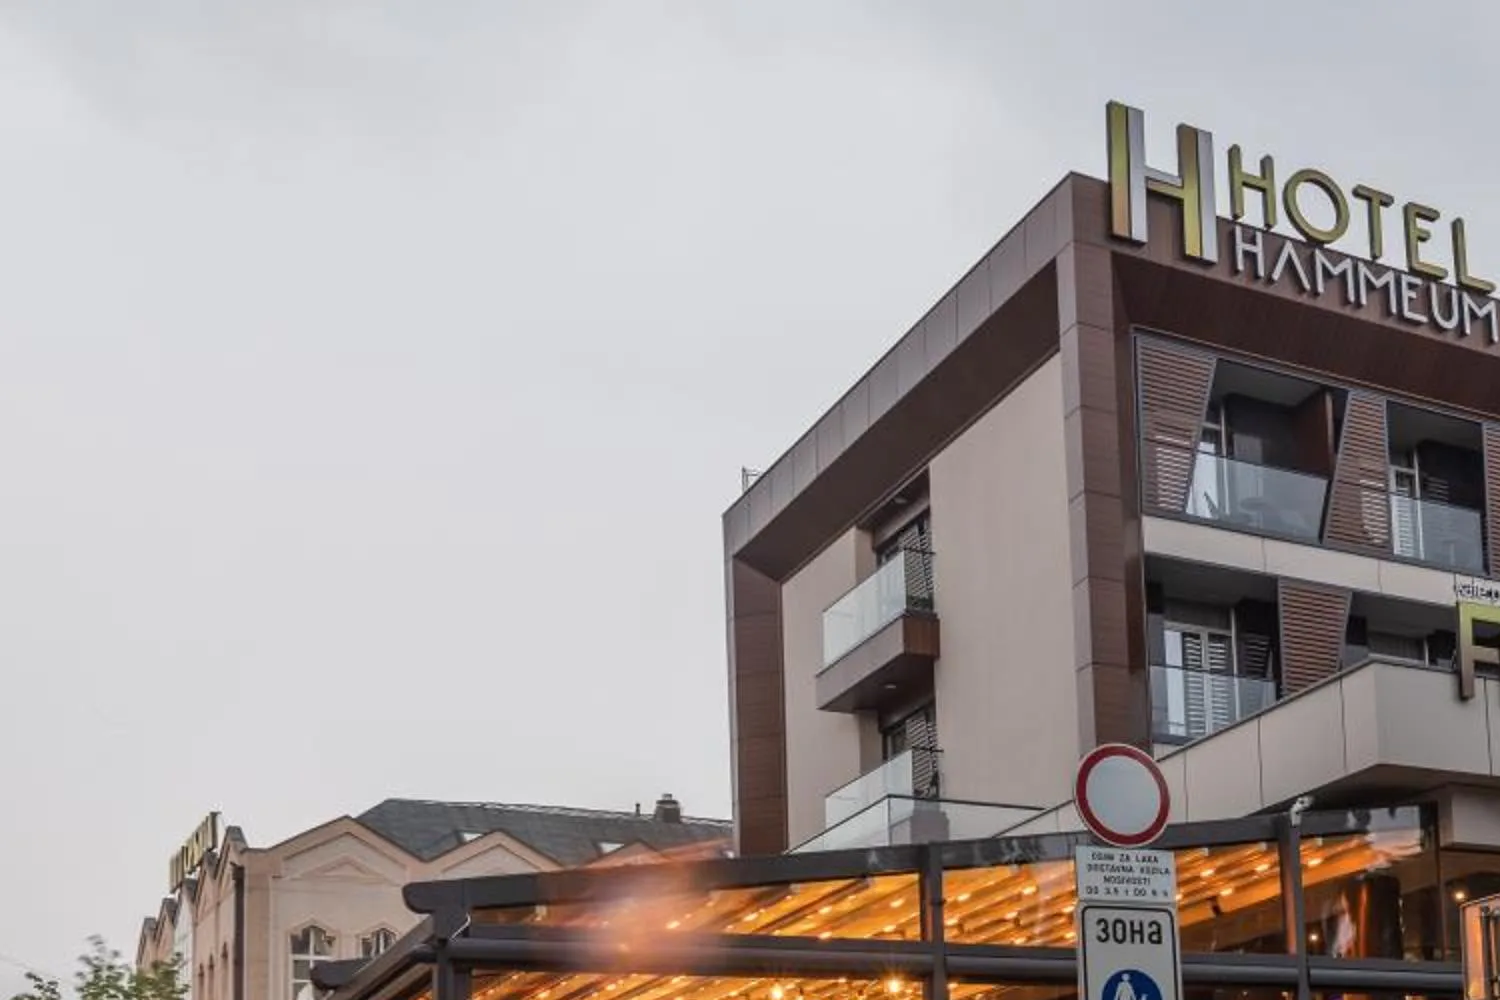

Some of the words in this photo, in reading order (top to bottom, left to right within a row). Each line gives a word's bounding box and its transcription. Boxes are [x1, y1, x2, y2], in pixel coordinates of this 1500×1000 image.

[1107, 100, 1218, 264] H
[1227, 143, 1497, 294] HOTEL
[1232, 223, 1500, 343] HAMMEUM
